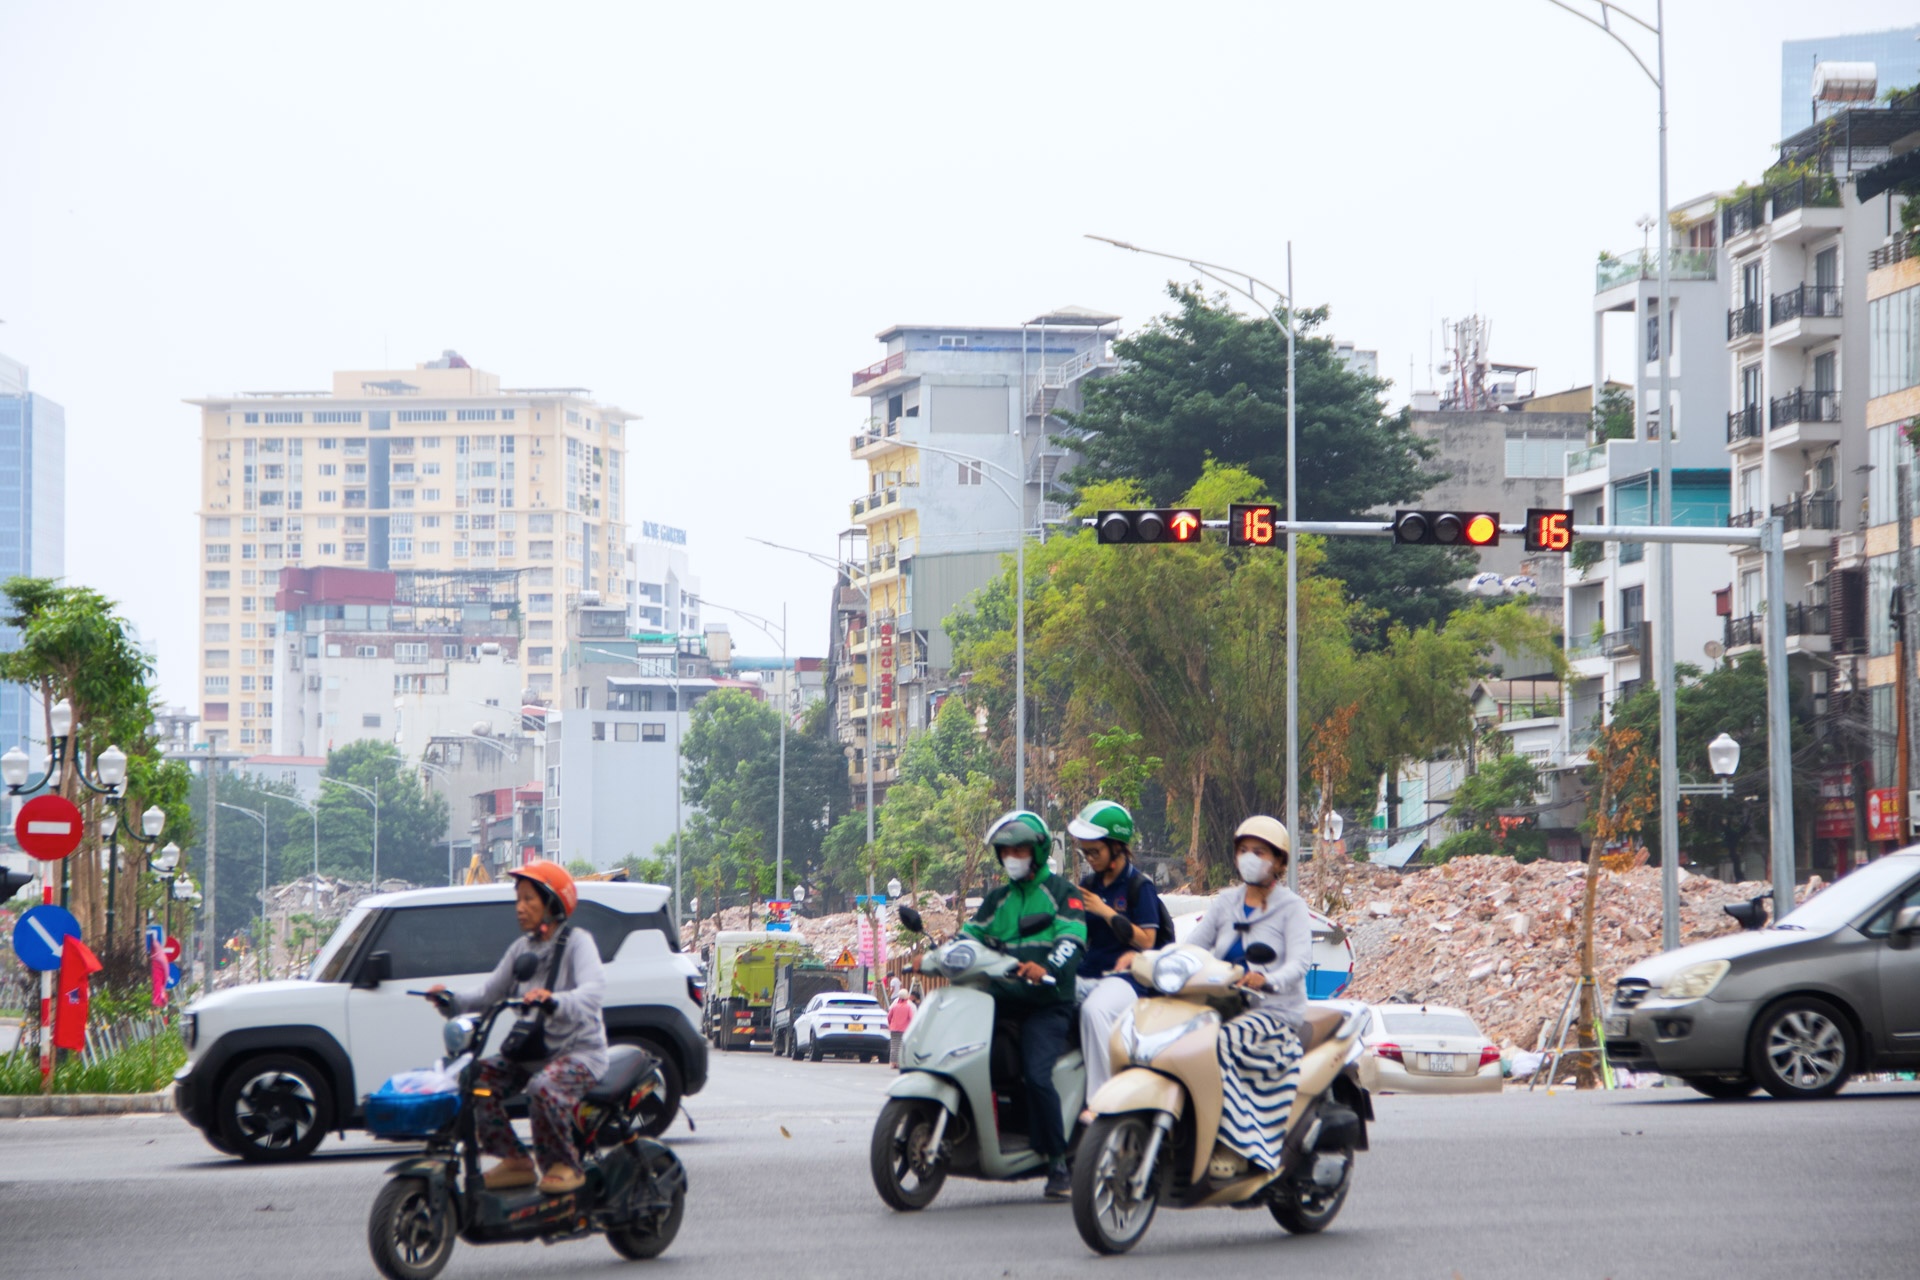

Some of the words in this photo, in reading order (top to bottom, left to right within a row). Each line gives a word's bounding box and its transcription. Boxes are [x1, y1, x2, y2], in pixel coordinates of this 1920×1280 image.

[1244, 508, 1273, 543] 16
[1539, 513, 1569, 549] 16
[881, 624, 893, 669] CLUB
